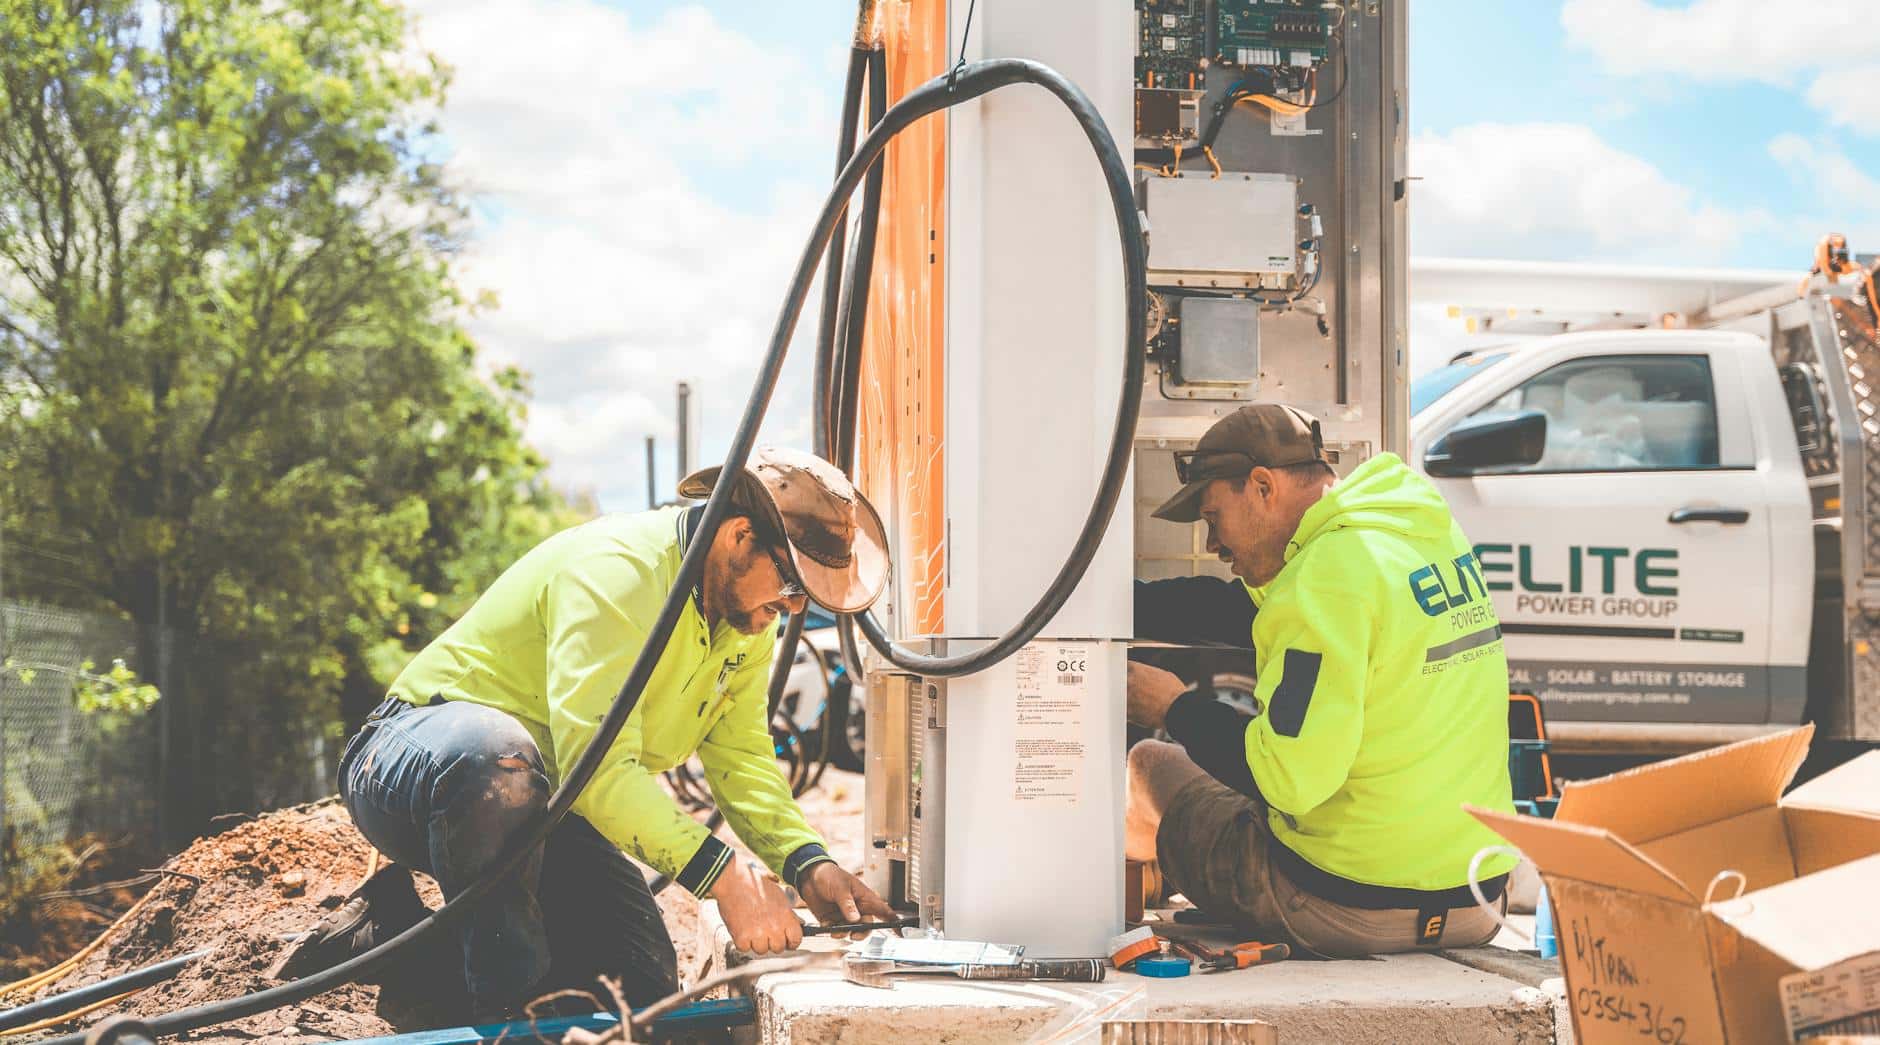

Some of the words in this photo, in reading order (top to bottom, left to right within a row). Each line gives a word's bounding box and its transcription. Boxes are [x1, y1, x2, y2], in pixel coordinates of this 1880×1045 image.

[1473, 543, 1679, 597] ELITE
[1409, 552, 1488, 617] ELIT
[1517, 594, 1596, 616] POWER
[1602, 597, 1678, 617] GROUP
[1451, 606, 1488, 632] POWER
[1548, 669, 1596, 685] SOLAR
[1611, 670, 1672, 687] BATTERY
[1677, 672, 1746, 688] STORAGE
[1539, 688, 1691, 705] elitepowergroup.com.au
